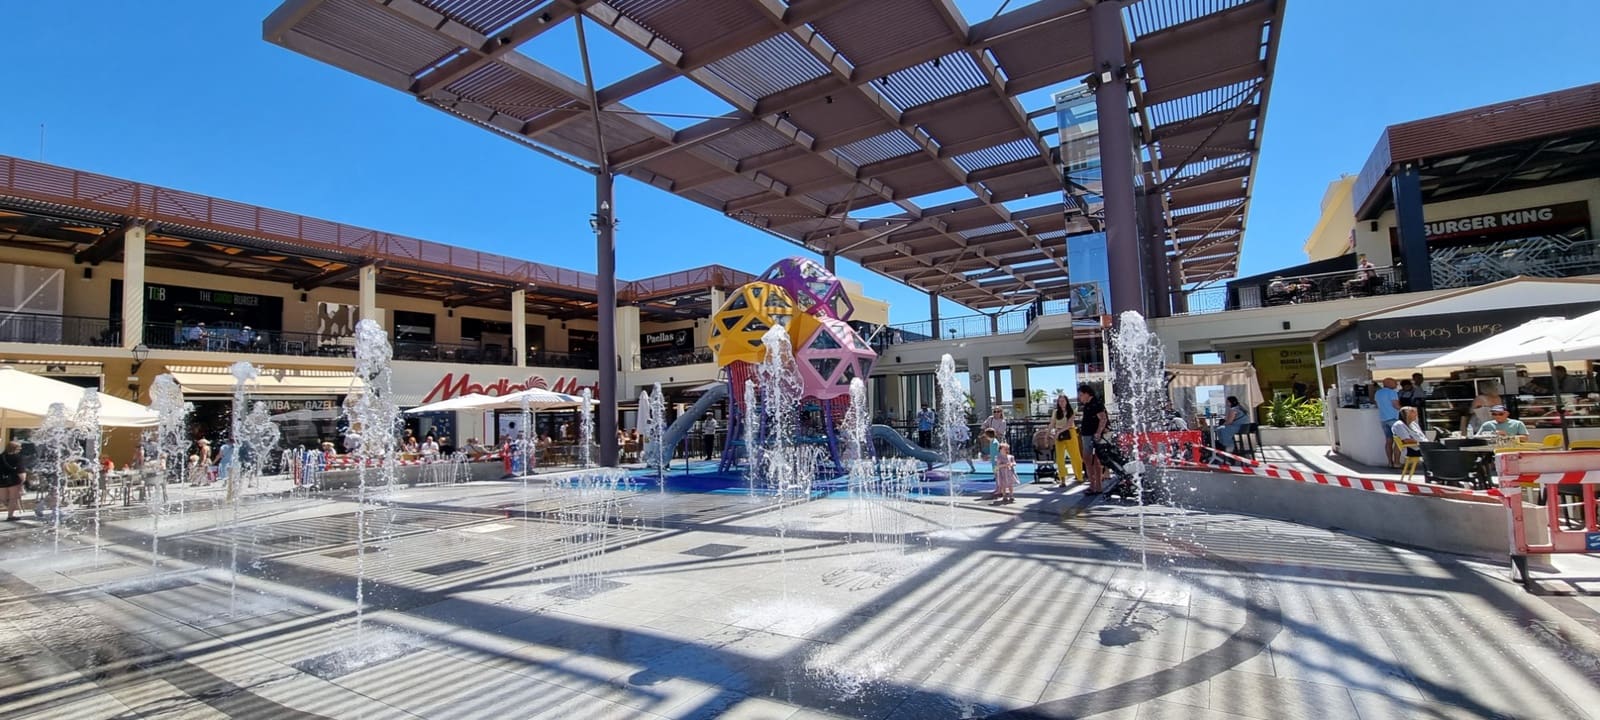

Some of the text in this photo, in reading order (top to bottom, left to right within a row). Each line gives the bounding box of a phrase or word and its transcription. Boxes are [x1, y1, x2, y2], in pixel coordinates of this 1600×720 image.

[1501, 208, 1553, 226] KING
[148, 286, 166, 301] TGB
[199, 290, 211, 302] THE
[233, 294, 259, 306] BURGER
[646, 332, 675, 345] Paellas
